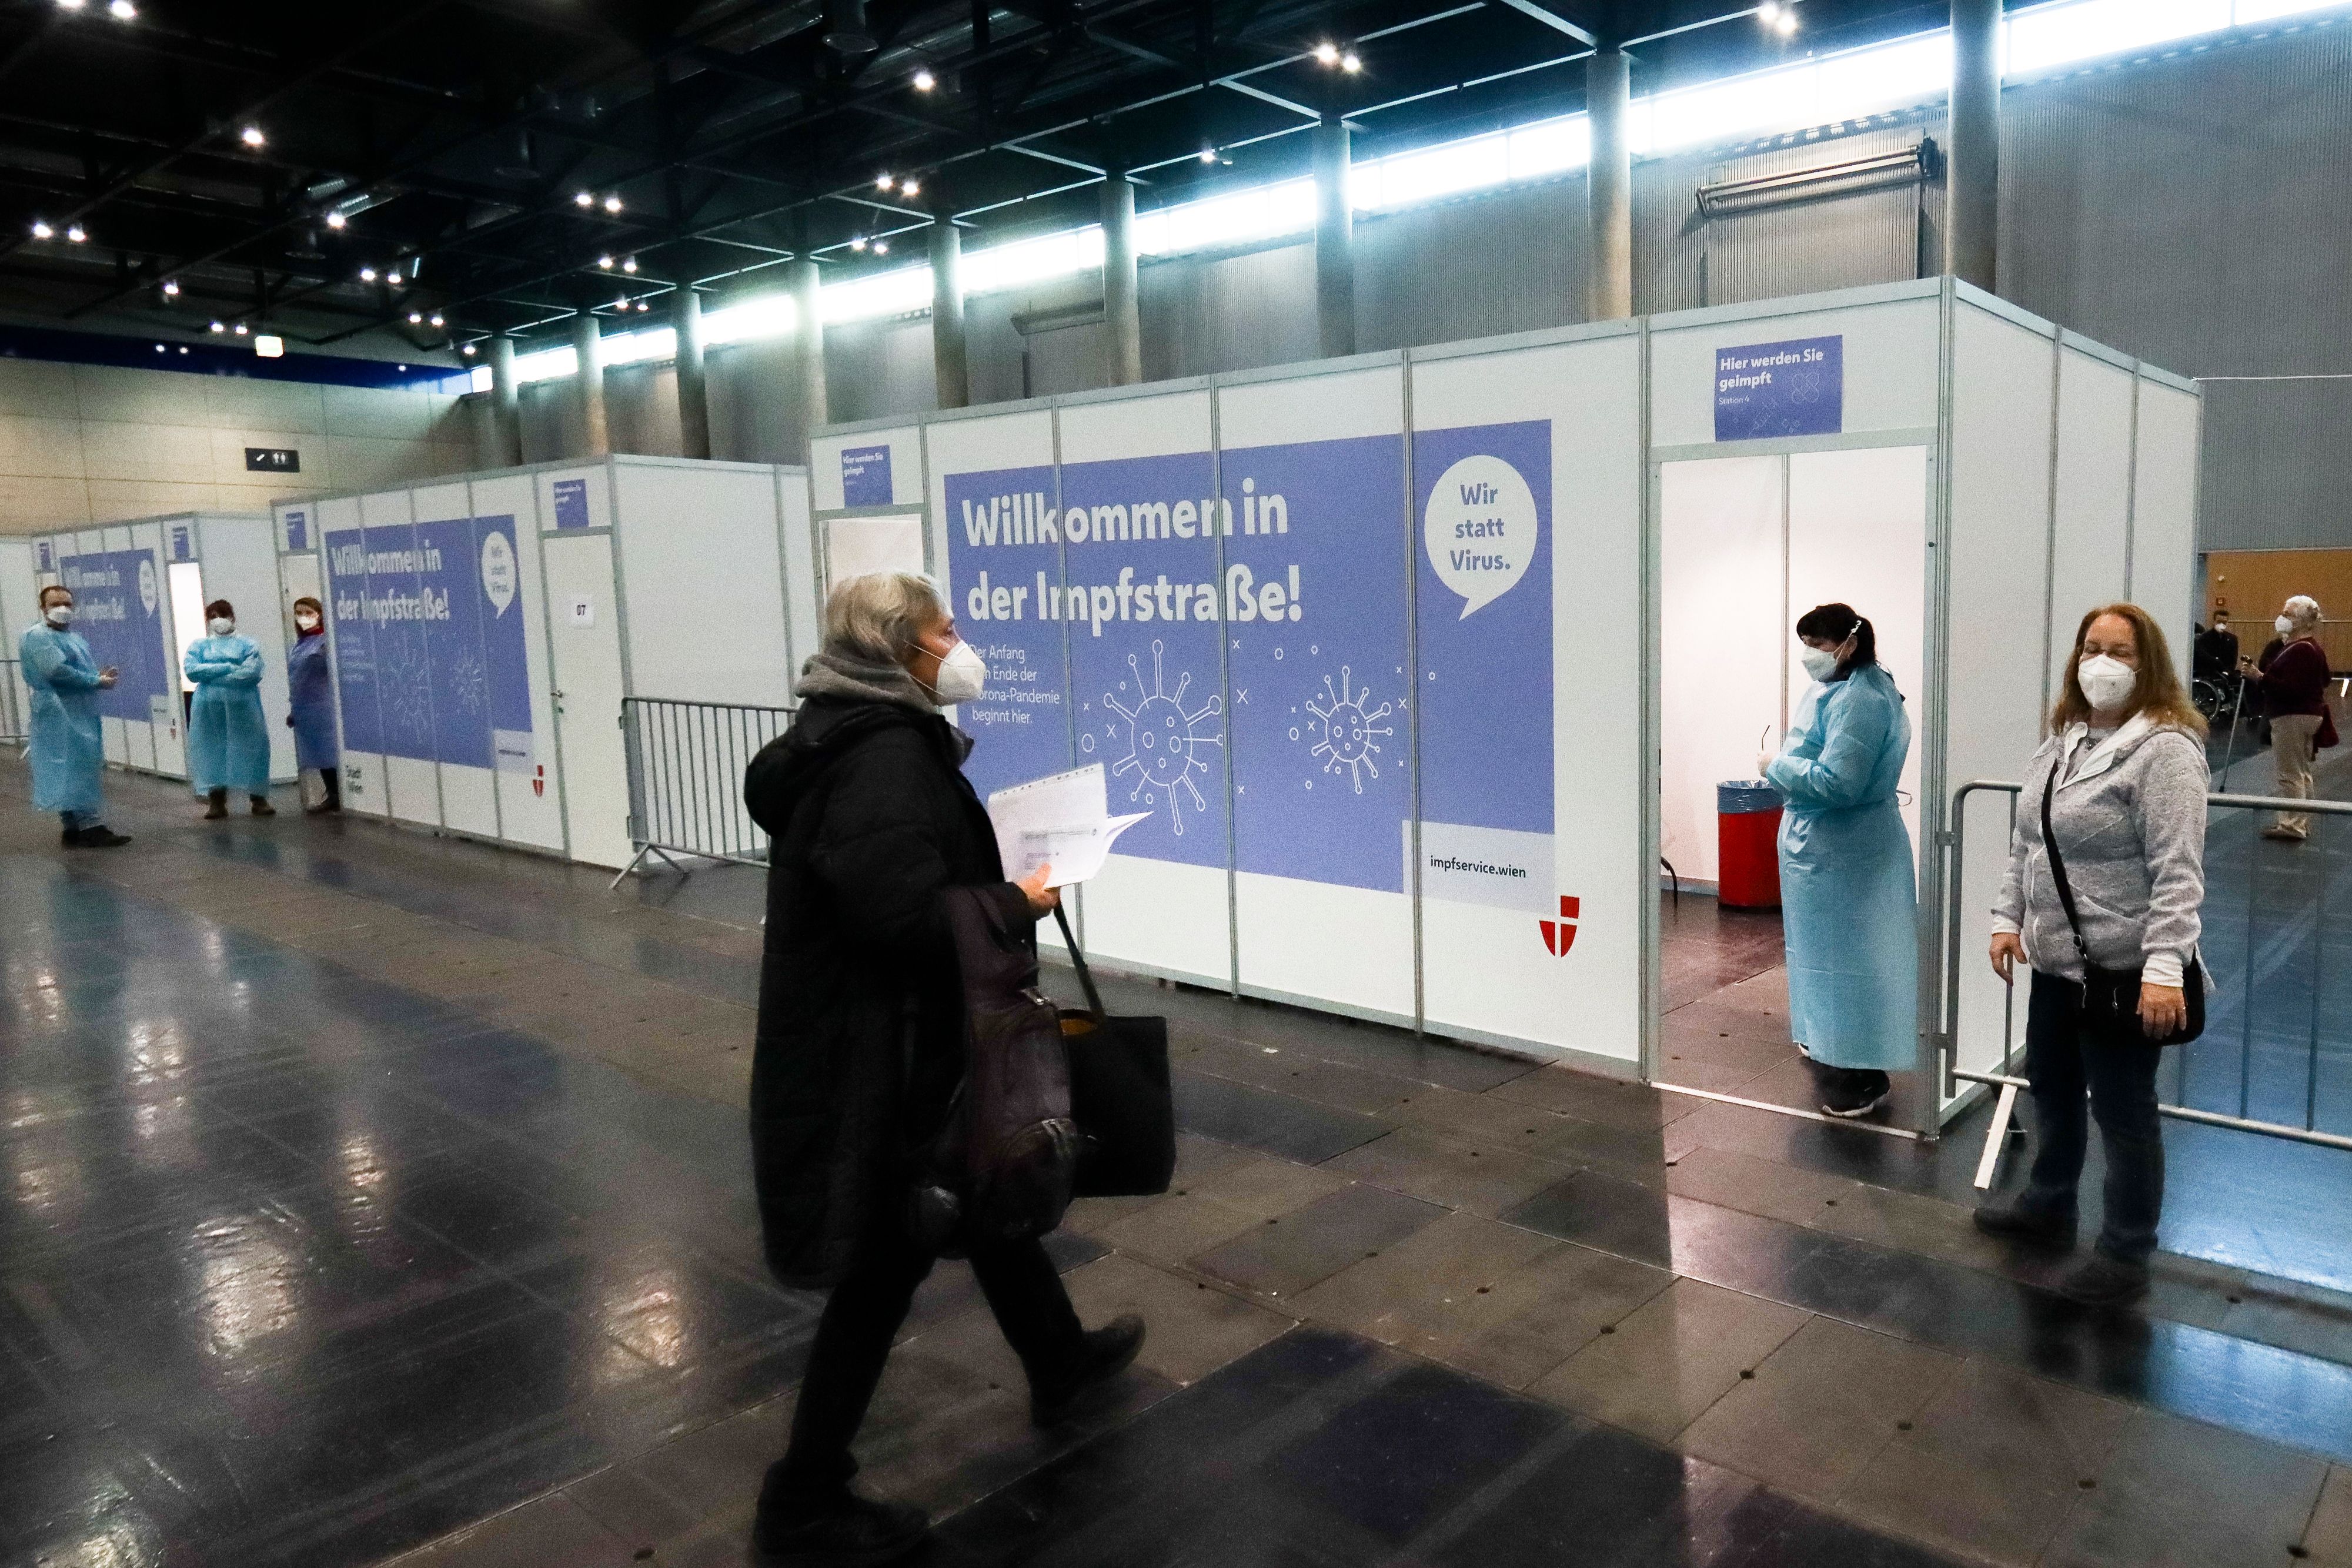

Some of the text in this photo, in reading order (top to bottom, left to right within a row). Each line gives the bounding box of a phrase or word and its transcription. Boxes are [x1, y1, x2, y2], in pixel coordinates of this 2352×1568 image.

[1721, 348, 1823, 371] Hier werden Sie
[1719, 372, 1772, 392] geimpft
[1719, 396, 1743, 405] Station
[1460, 483, 1498, 506] Wir
[962, 477, 1288, 547] Willkommen in
[1455, 518, 1505, 539] statt
[1450, 549, 1511, 571] Virus.
[967, 563, 1302, 637] der Impfstraße!
[989, 644, 1025, 664] Anfang
[994, 666, 1018, 681] Ende
[1020, 666, 1037, 681] der
[978, 687, 1060, 704] orona-Pandemie
[972, 706, 1033, 725] beginnt hier.
[1431, 855, 1526, 878] impfservice.wien
